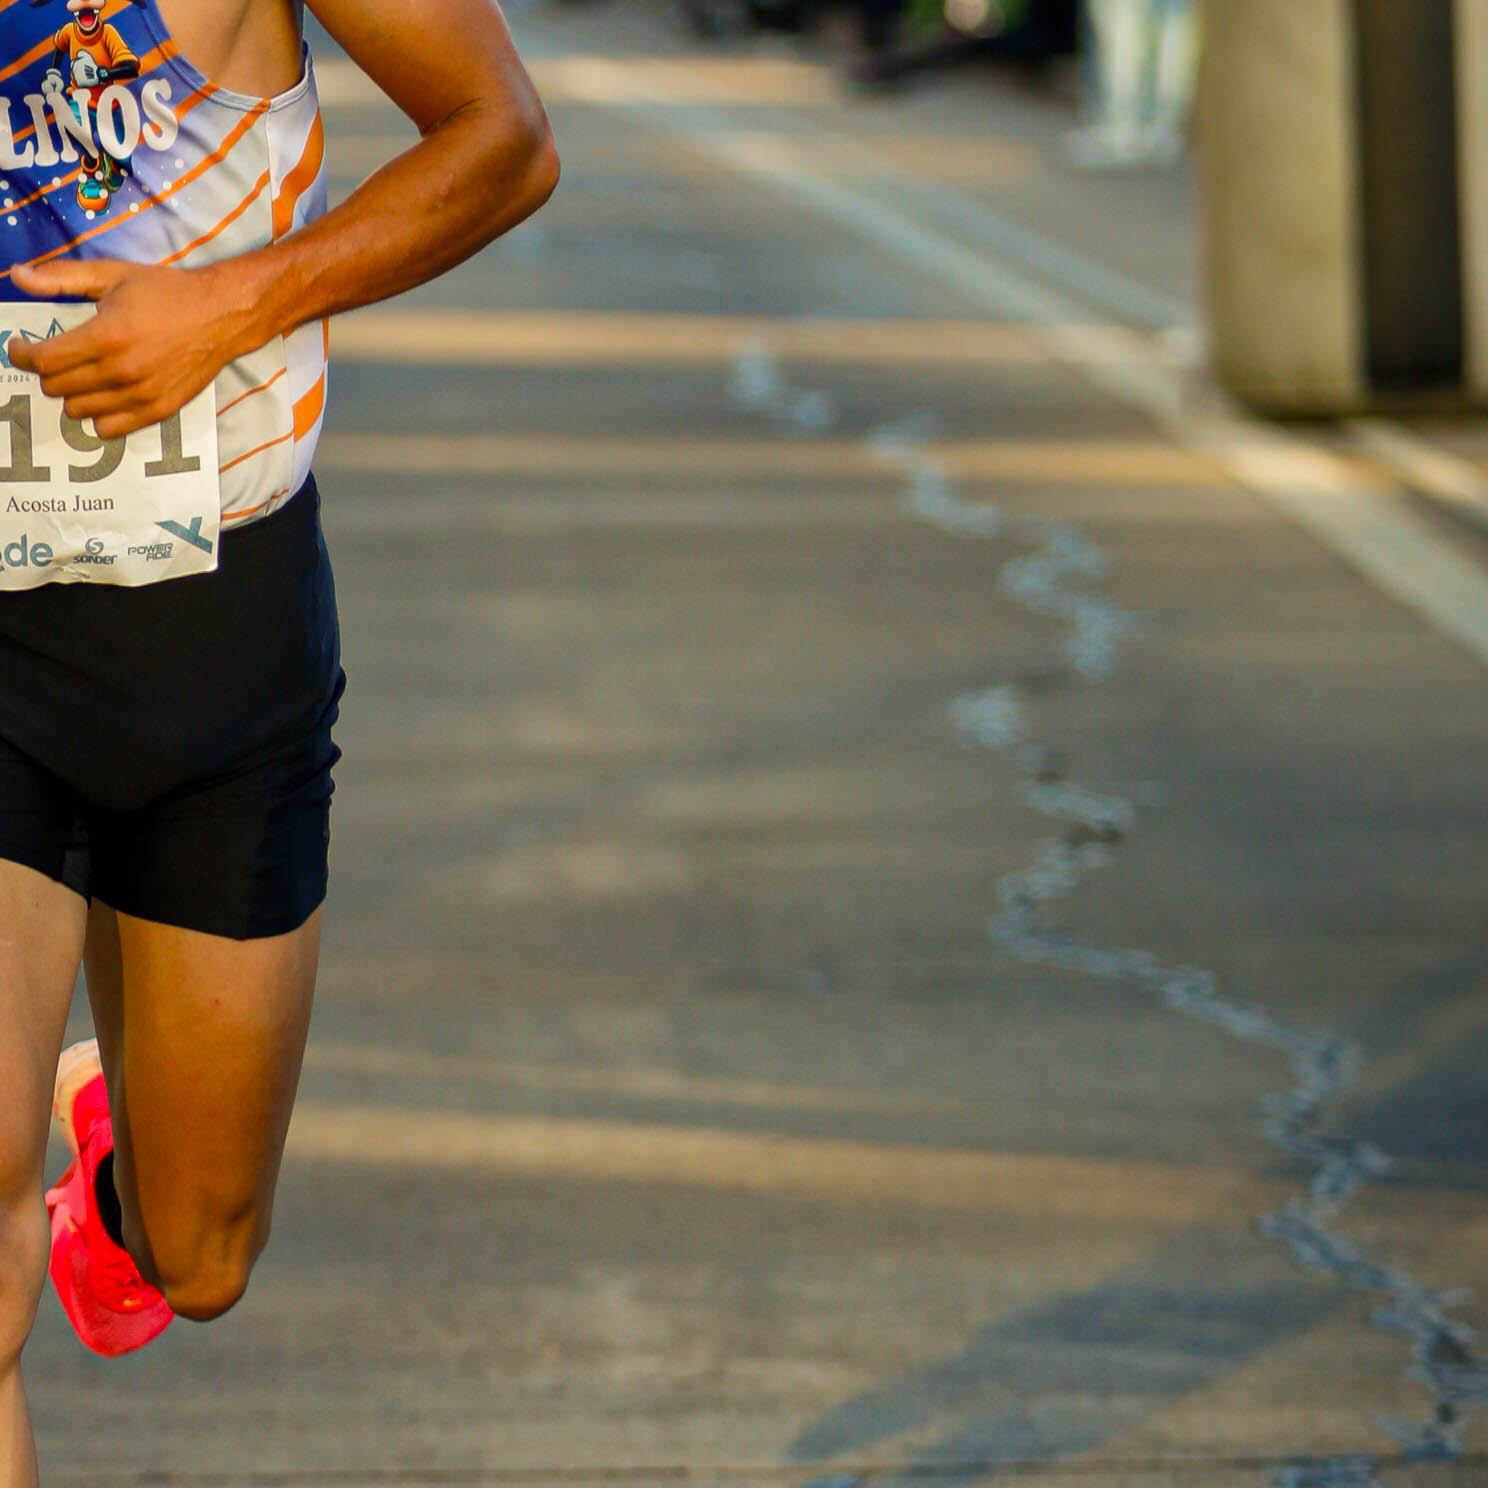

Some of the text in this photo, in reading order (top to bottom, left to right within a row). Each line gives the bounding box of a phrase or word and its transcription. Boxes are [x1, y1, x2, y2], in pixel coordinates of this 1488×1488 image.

[6, 494, 115, 513] Acosta Juan
[127, 543, 173, 555] POWER
